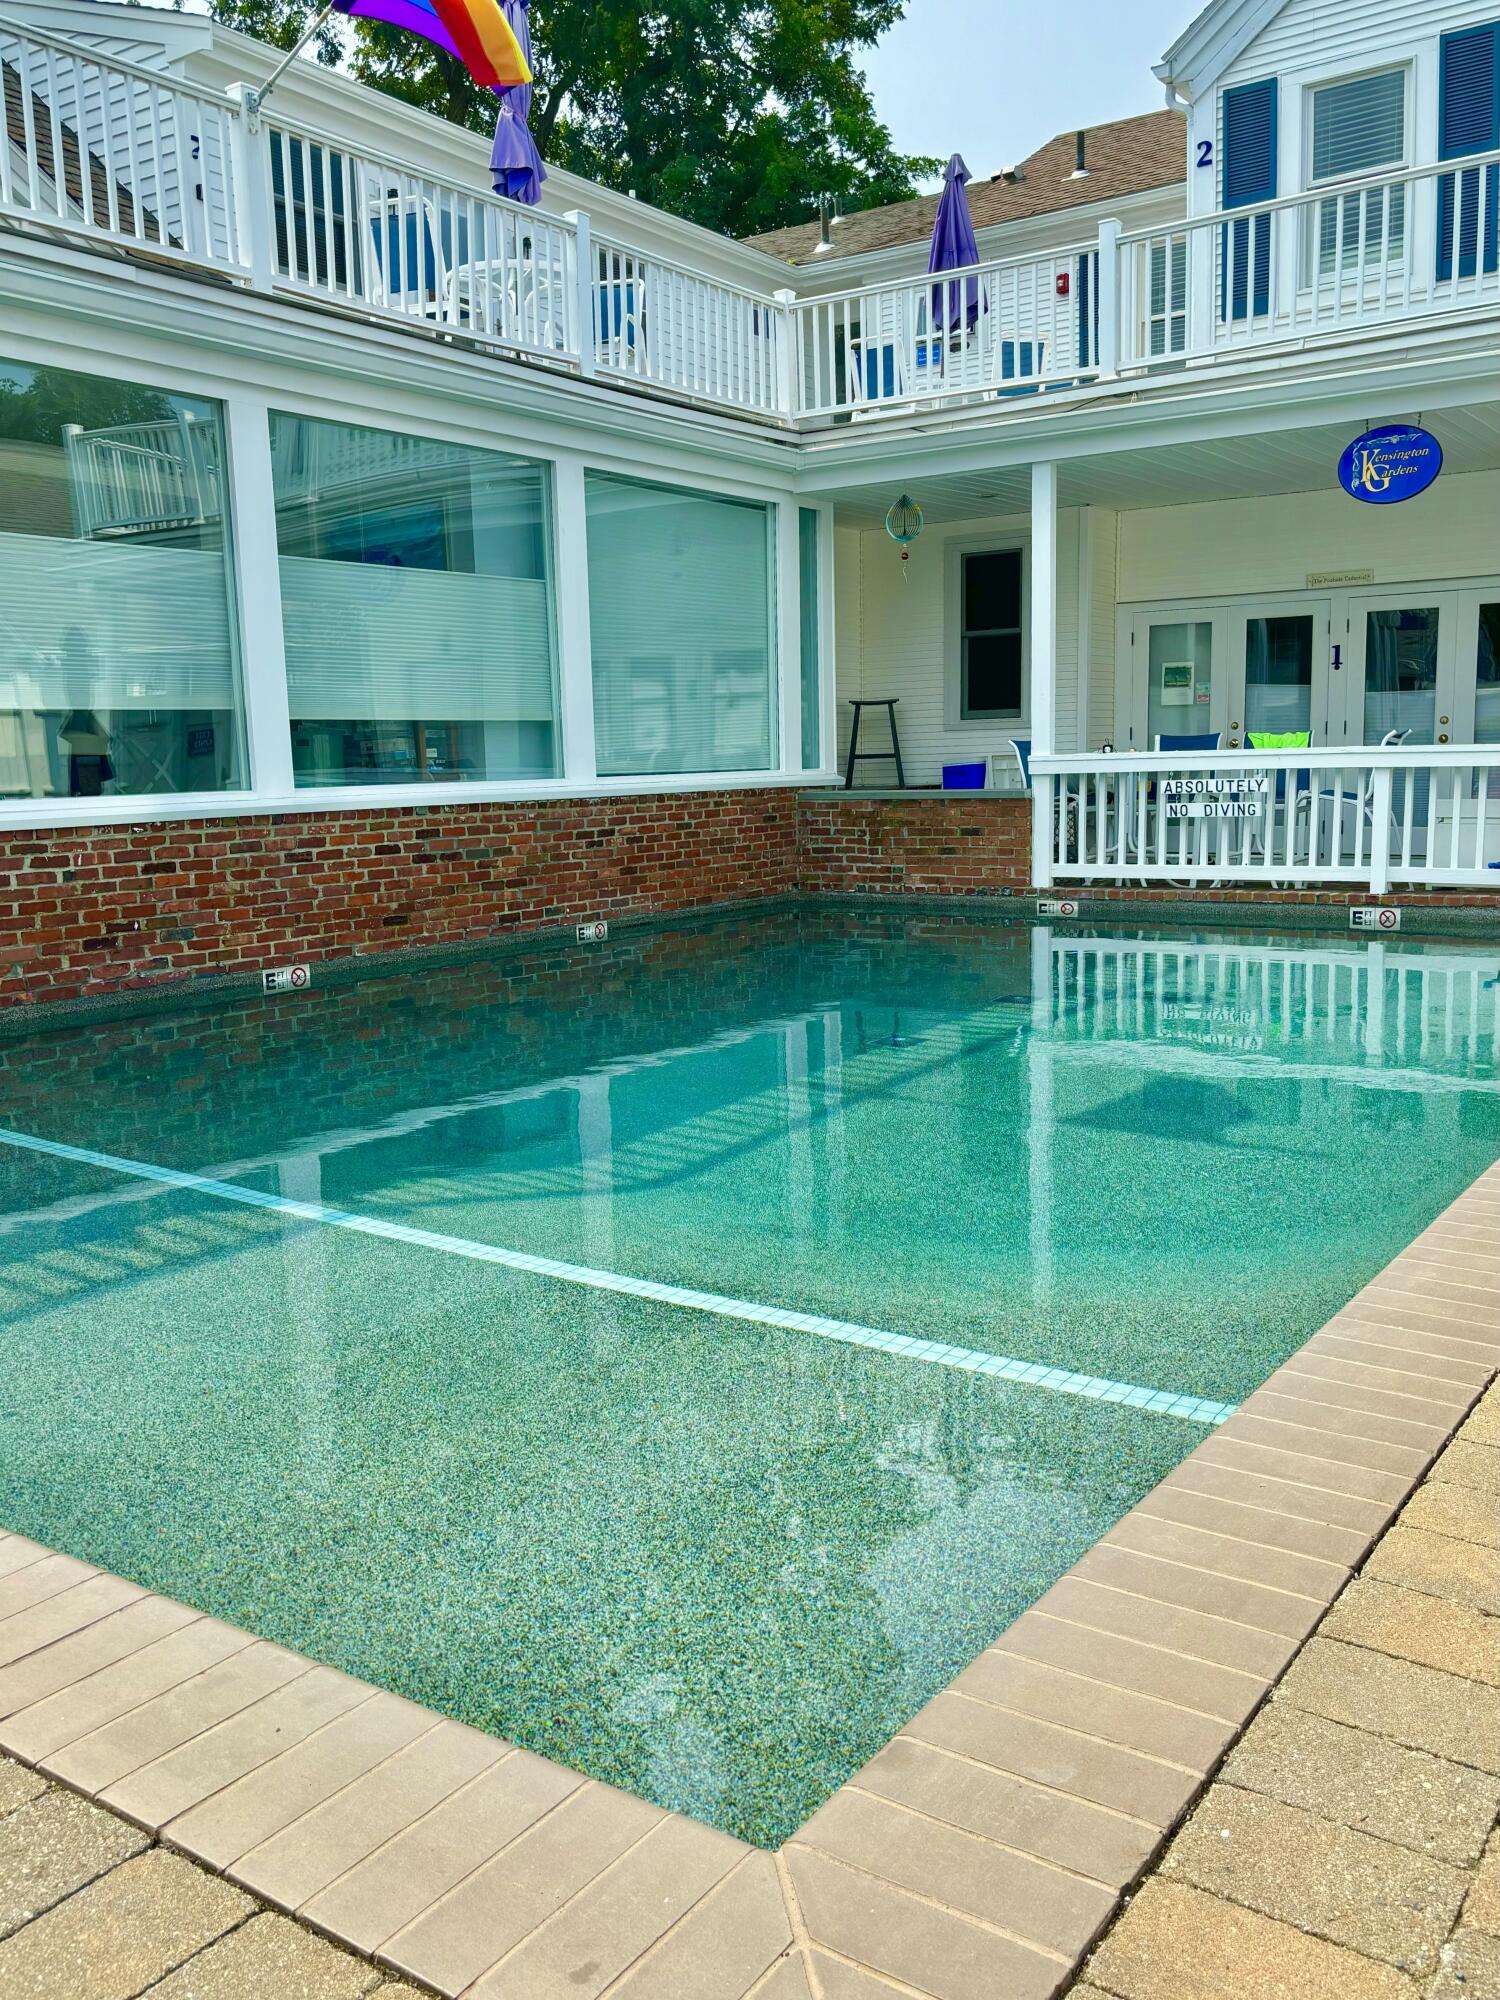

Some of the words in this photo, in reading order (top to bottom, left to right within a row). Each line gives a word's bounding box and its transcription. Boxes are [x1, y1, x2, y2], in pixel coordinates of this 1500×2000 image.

[1196, 140, 1213, 168] 2
[1360, 447, 1430, 483] Kensington
[1365, 463, 1418, 493] Gardens
[1331, 645, 1343, 666] 1
[1163, 779, 1264, 794] ABSOLUTELY
[1169, 804, 1189, 817] NO
[1204, 803, 1257, 817] DIVING
